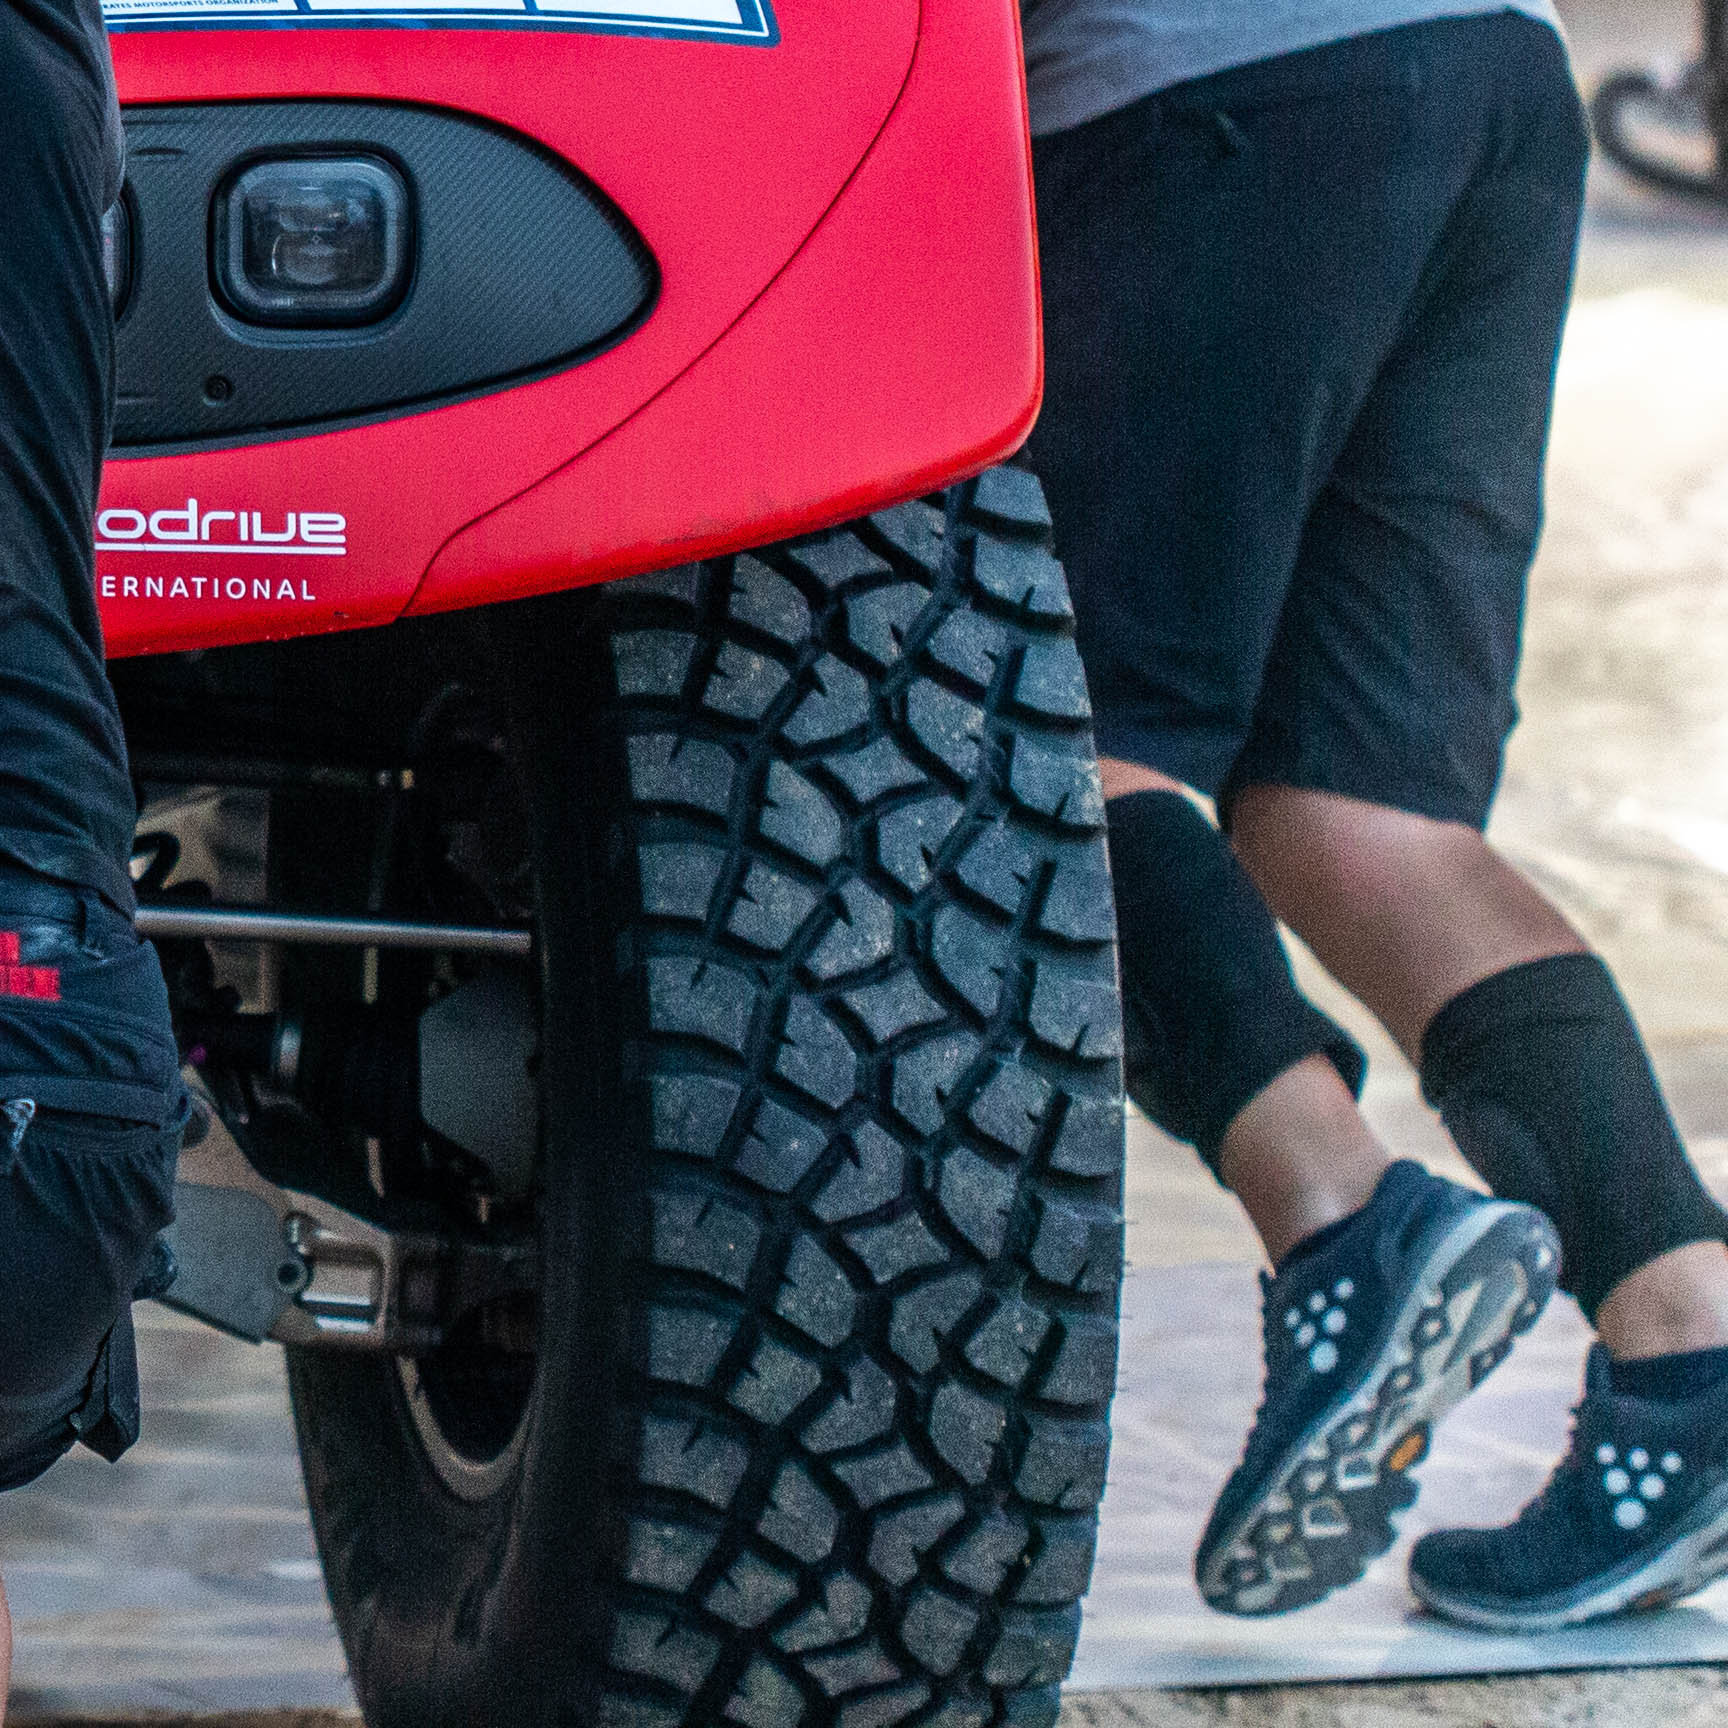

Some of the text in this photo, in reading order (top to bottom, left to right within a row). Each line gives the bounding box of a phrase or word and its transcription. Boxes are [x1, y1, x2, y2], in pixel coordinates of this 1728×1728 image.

[101, 1, 133, 10] RATES
[97, 497, 347, 544] odrive
[100, 575, 317, 601] ERNATIONAL
